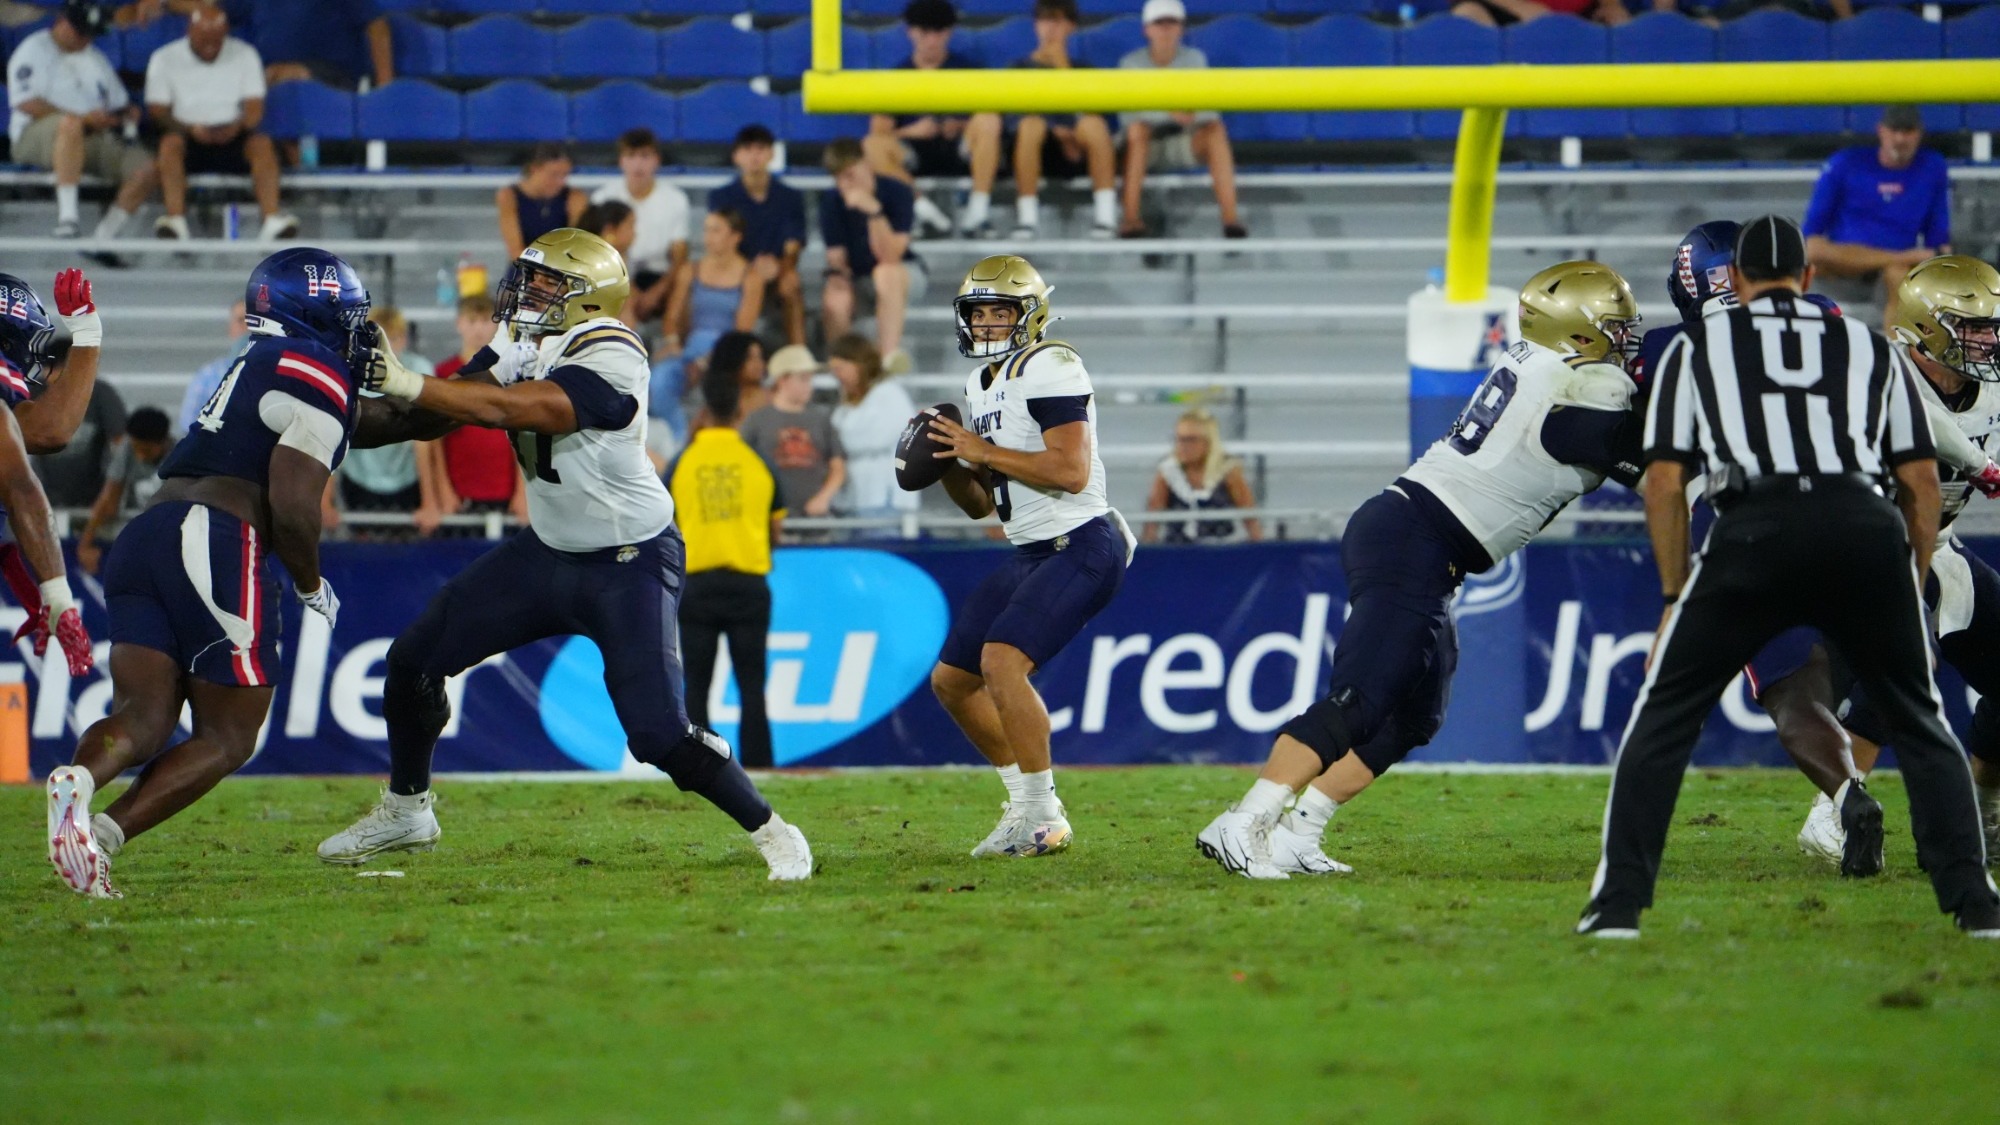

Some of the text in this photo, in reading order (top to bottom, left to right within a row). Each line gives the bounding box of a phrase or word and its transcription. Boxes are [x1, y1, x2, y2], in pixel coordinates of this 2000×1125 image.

[304, 265, 341, 296] 14
[972, 287, 989, 295] NAVY
[1752, 315, 1826, 388] U
[972, 410, 1002, 436] NAVY
